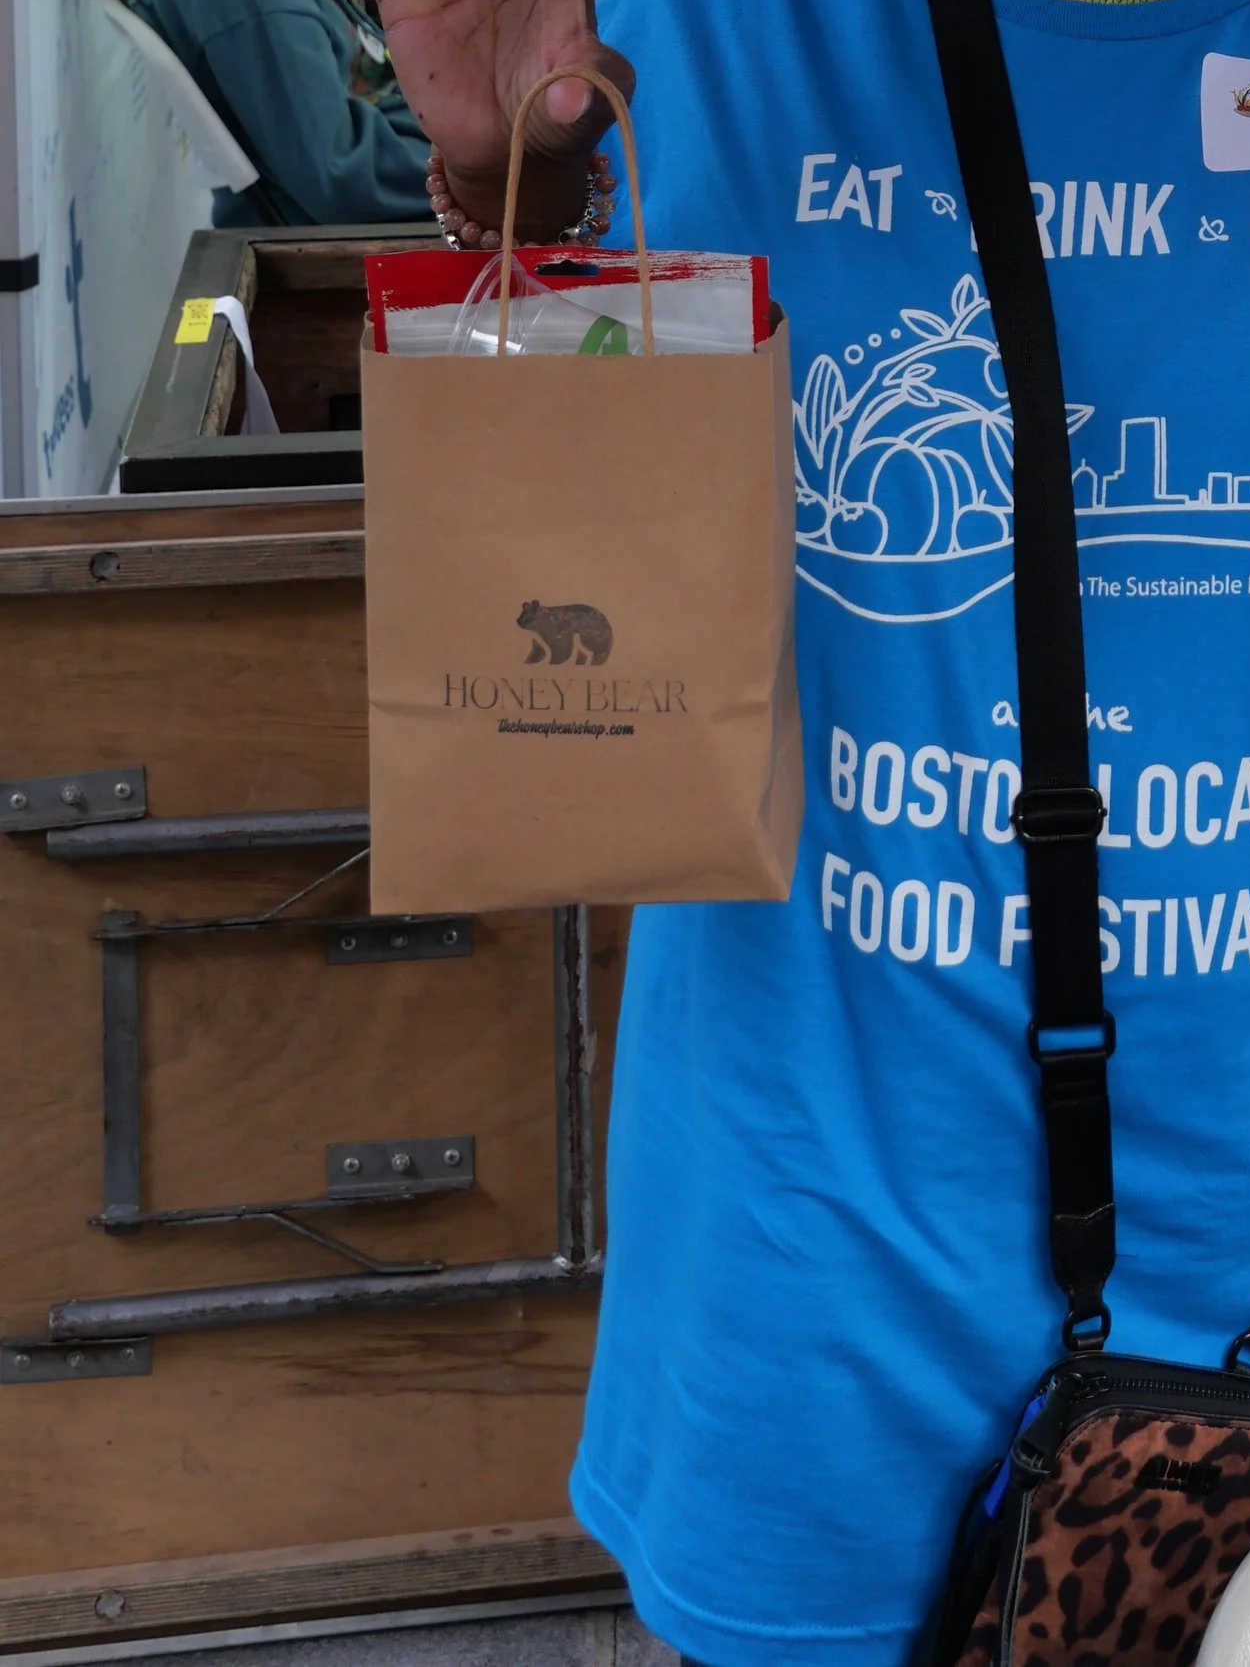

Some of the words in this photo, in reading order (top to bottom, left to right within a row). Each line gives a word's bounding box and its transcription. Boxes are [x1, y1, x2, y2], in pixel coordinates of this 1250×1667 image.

[796, 153, 903, 233] EAT
[972, 181, 1175, 258] RINK
[1198, 216, 1230, 243] &
[1087, 576, 1121, 597] The
[1126, 575, 1243, 597] Sustainable
[442, 672, 574, 711] HONEY
[586, 679, 689, 714] BEAR
[991, 698, 1019, 727] a
[1085, 692, 1133, 733] he
[830, 725, 1022, 845] BOSTO
[822, 851, 976, 967] FOOD
